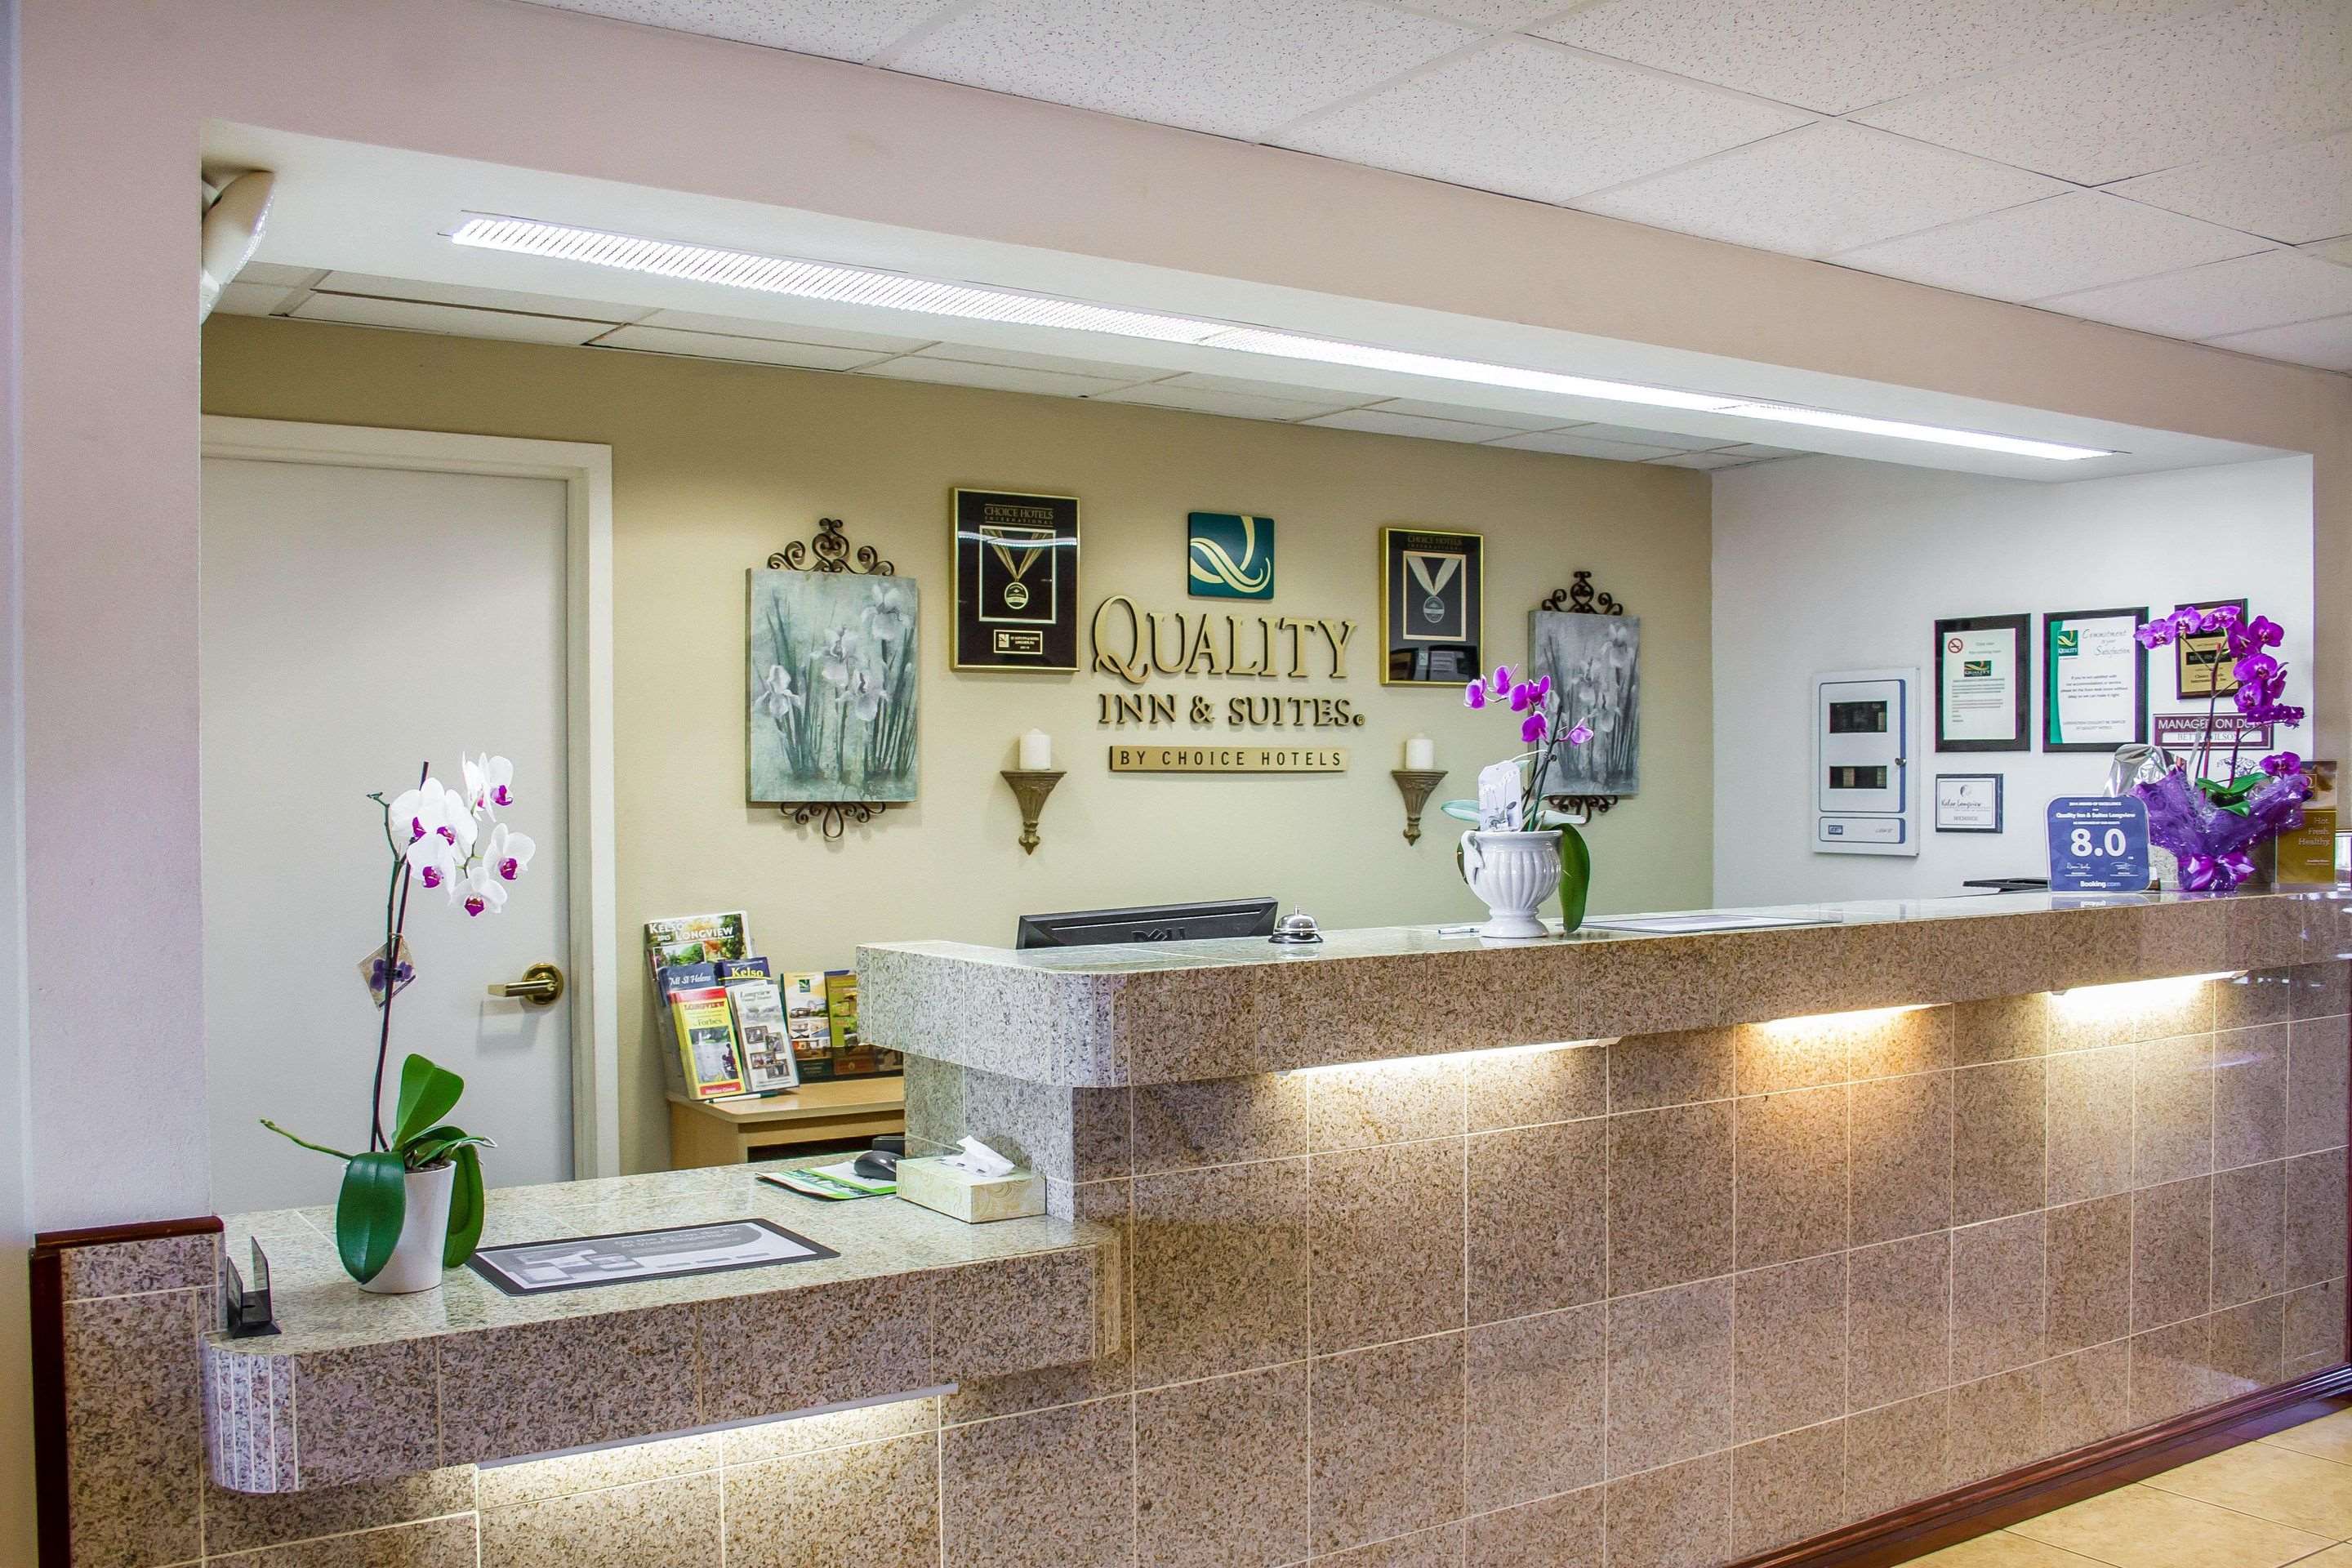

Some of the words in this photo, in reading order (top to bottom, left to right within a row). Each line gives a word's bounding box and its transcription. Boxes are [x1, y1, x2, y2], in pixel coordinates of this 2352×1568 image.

[983, 506, 1018, 518] CHOICE
[1020, 510, 1054, 520] HOTELS
[1091, 595, 1357, 684] QUALITY
[2082, 628, 2127, 639] Commitment
[1098, 693, 1178, 724] INN
[1190, 695, 1215, 724] &
[2215, 718, 2233, 728] ON
[1120, 751, 1146, 765] BY
[1161, 751, 1245, 765] CHOICE
[1261, 751, 1341, 766] HOTELS
[2070, 827, 2127, 858] 8.0
[649, 922, 685, 934] KELSO
[675, 926, 734, 942] LONGVIEW
[691, 973, 711, 983] Helens
[731, 966, 764, 978] Kelso
